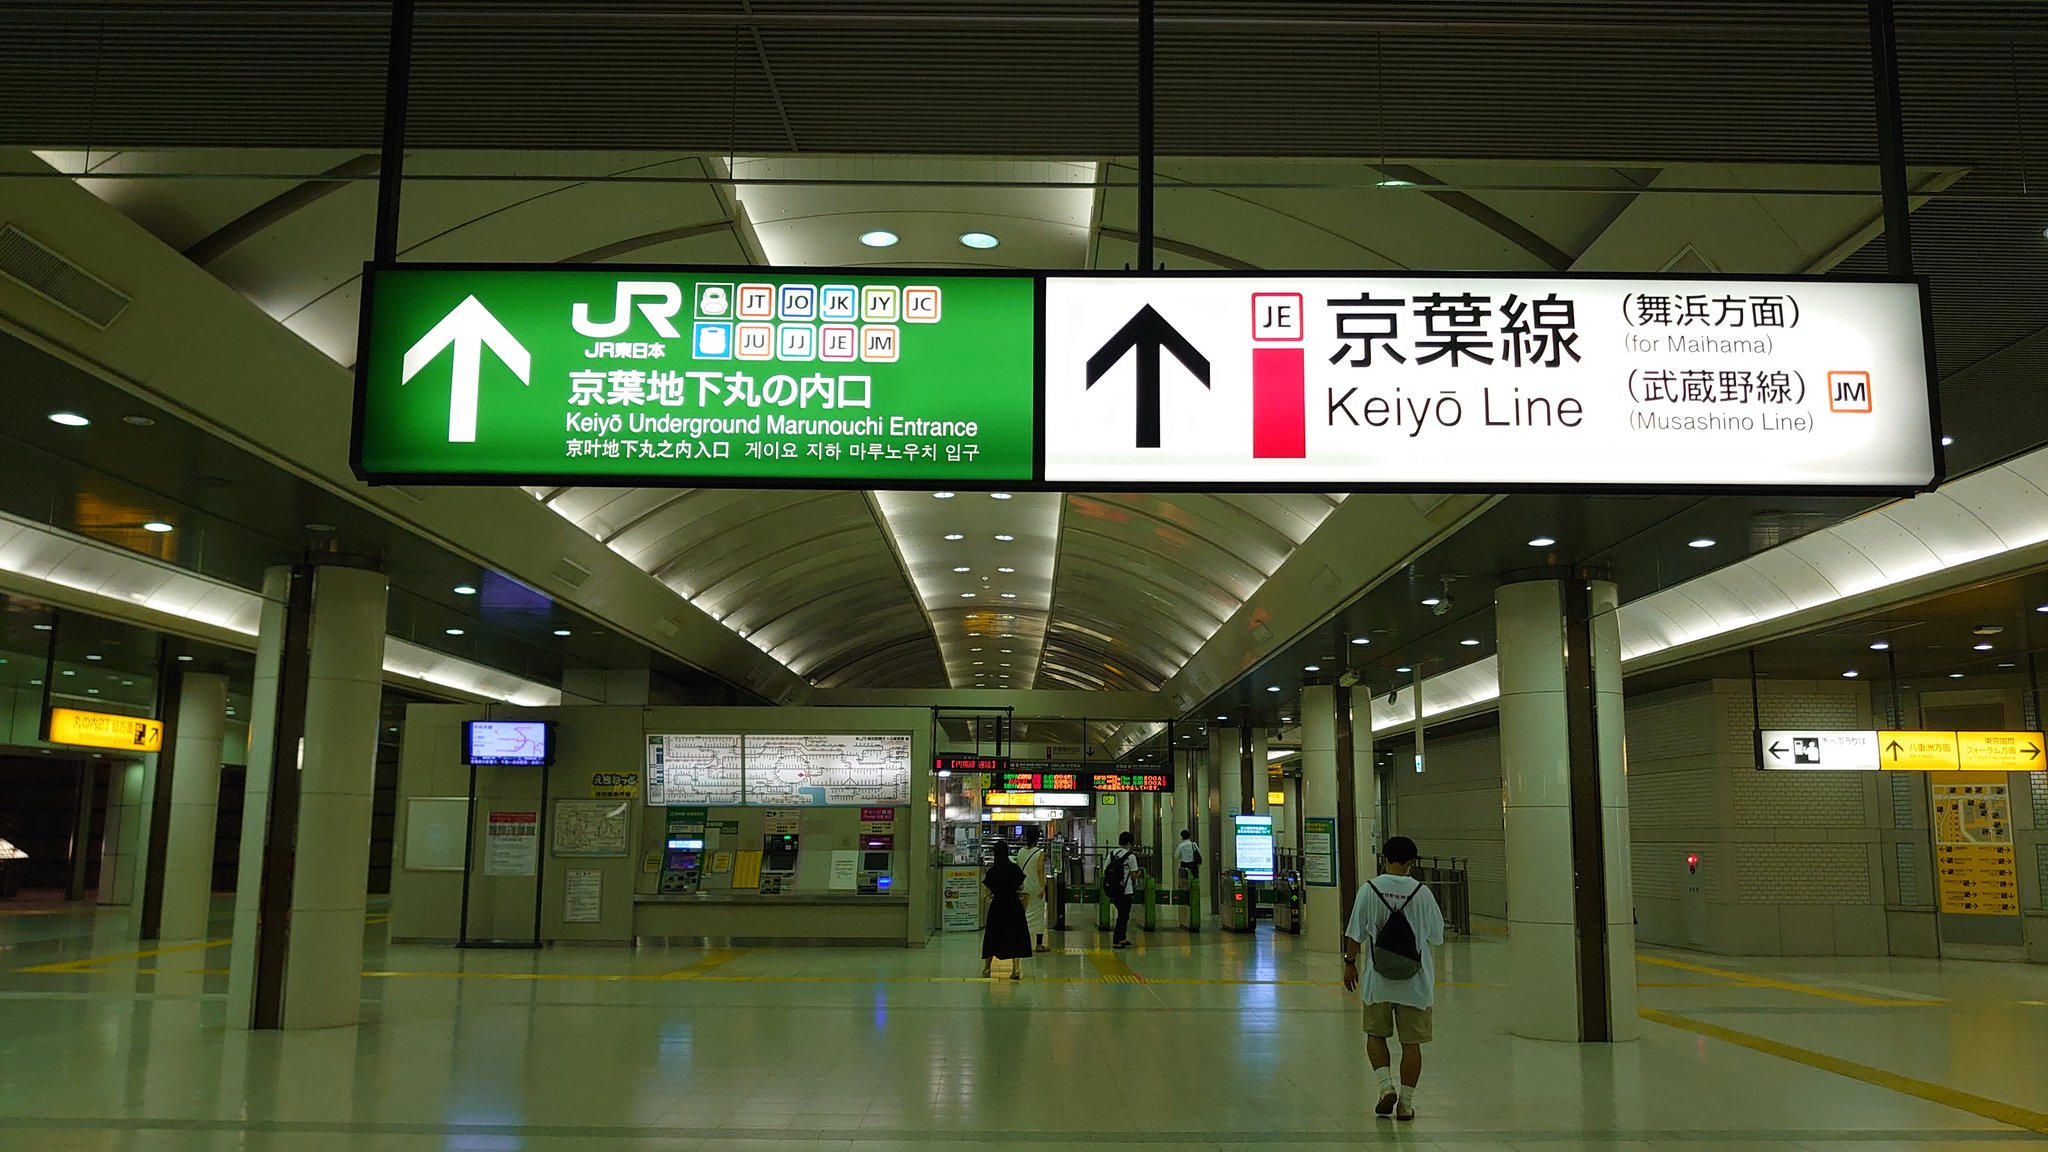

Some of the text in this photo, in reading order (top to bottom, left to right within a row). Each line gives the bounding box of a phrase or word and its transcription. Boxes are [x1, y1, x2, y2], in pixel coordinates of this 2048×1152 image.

[572, 281, 682, 338] JR
[746, 294, 932, 311] JT JO JK JY JC
[1263, 306, 1291, 328] JE
[1326, 292, 1582, 367] 京葉線
[585, 341, 666, 359] JR東日本
[743, 334, 892, 350] JU JJ JE JM
[1624, 332, 1774, 355] (for Maihama)
[567, 369, 872, 409] 京葉地下丸の内口
[1834, 382, 1867, 402] JM
[1327, 386, 1584, 438] Keiyō Line
[1629, 409, 1815, 433] (Musashino Line)
[565, 411, 979, 438] Keiyō Underground Marunouchi Entrance
[565, 438, 730, 459] 京叶地下丸之内入口
[744, 440, 981, 462] 게이요 지하 마루노우치 입구
[1909, 743, 1952, 752] 八重洲方面
